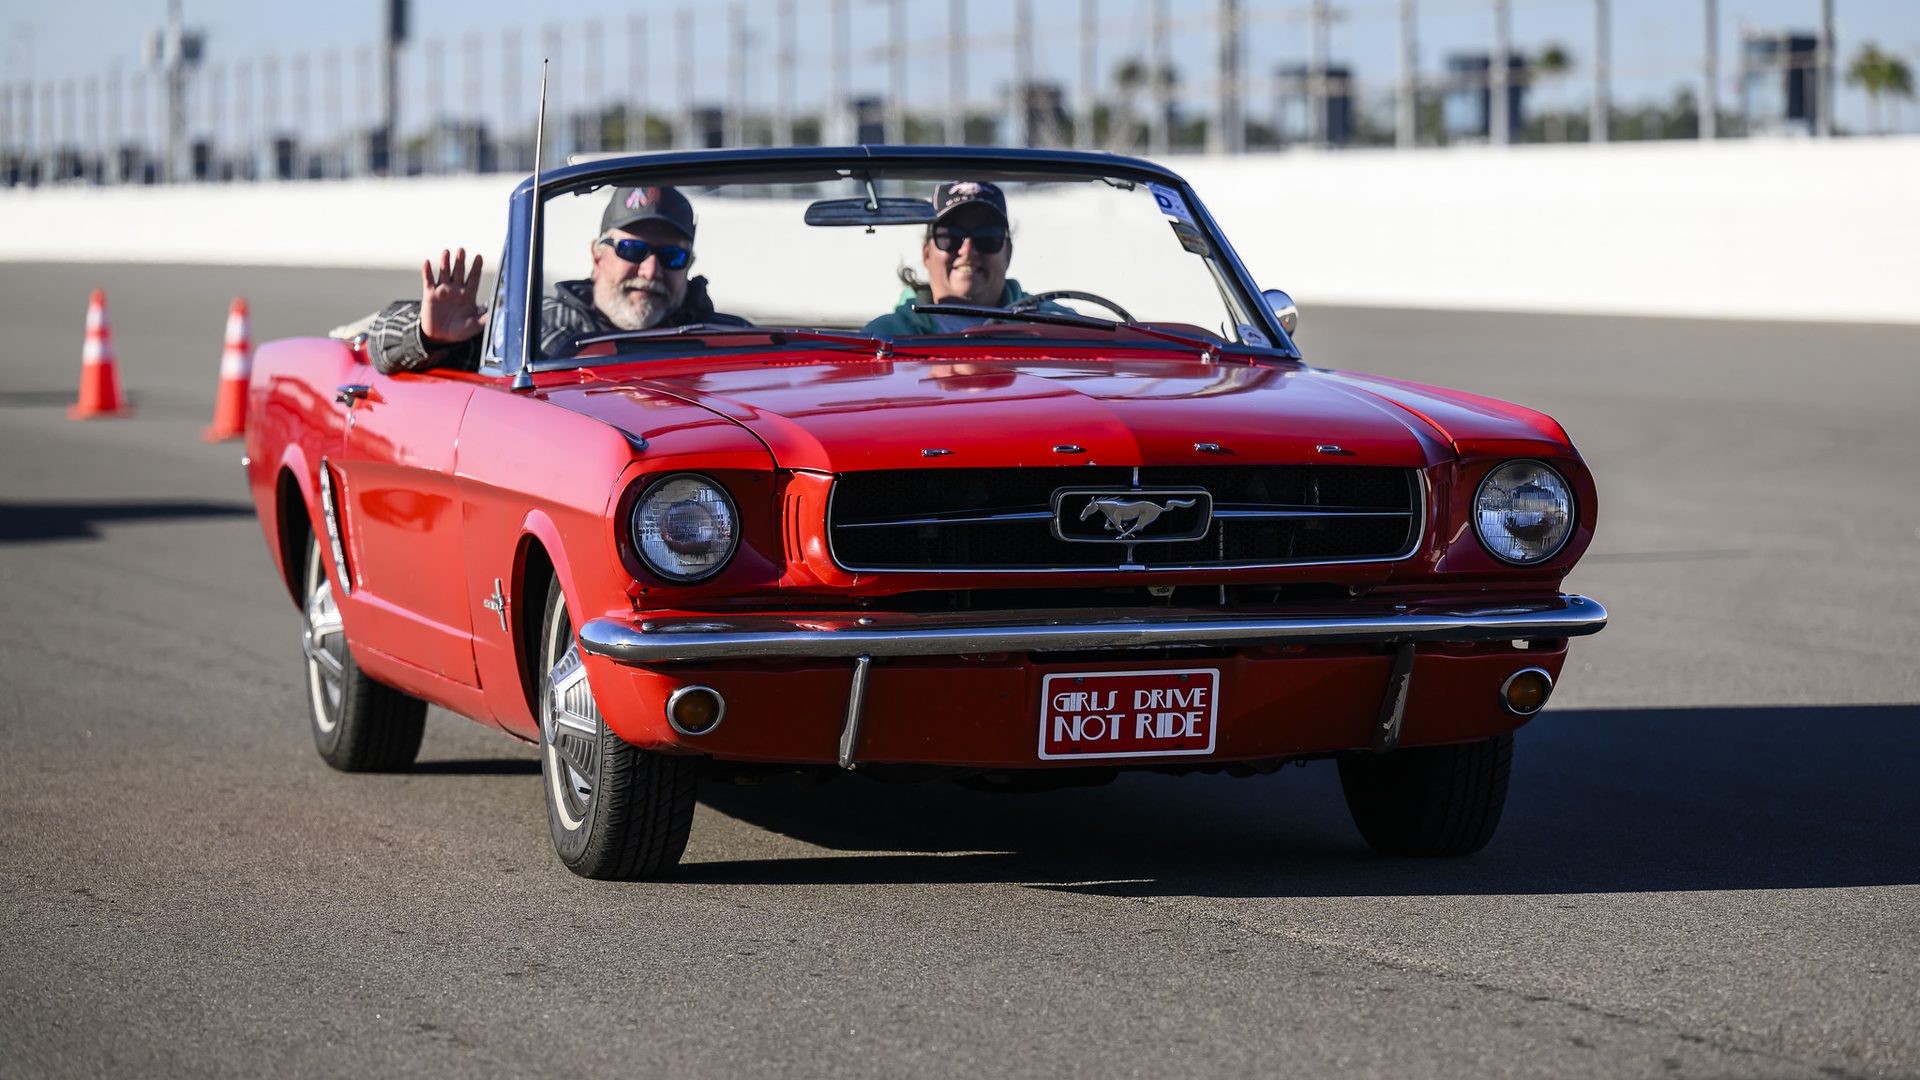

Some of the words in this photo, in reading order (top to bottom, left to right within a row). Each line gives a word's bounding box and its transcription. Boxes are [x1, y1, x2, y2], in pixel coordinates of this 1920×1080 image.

[1053, 690, 1119, 712] GIRLS
[1133, 687, 1208, 710] DRIVE
[1053, 713, 1126, 742] NOT
[1135, 711, 1204, 739] RIDE
